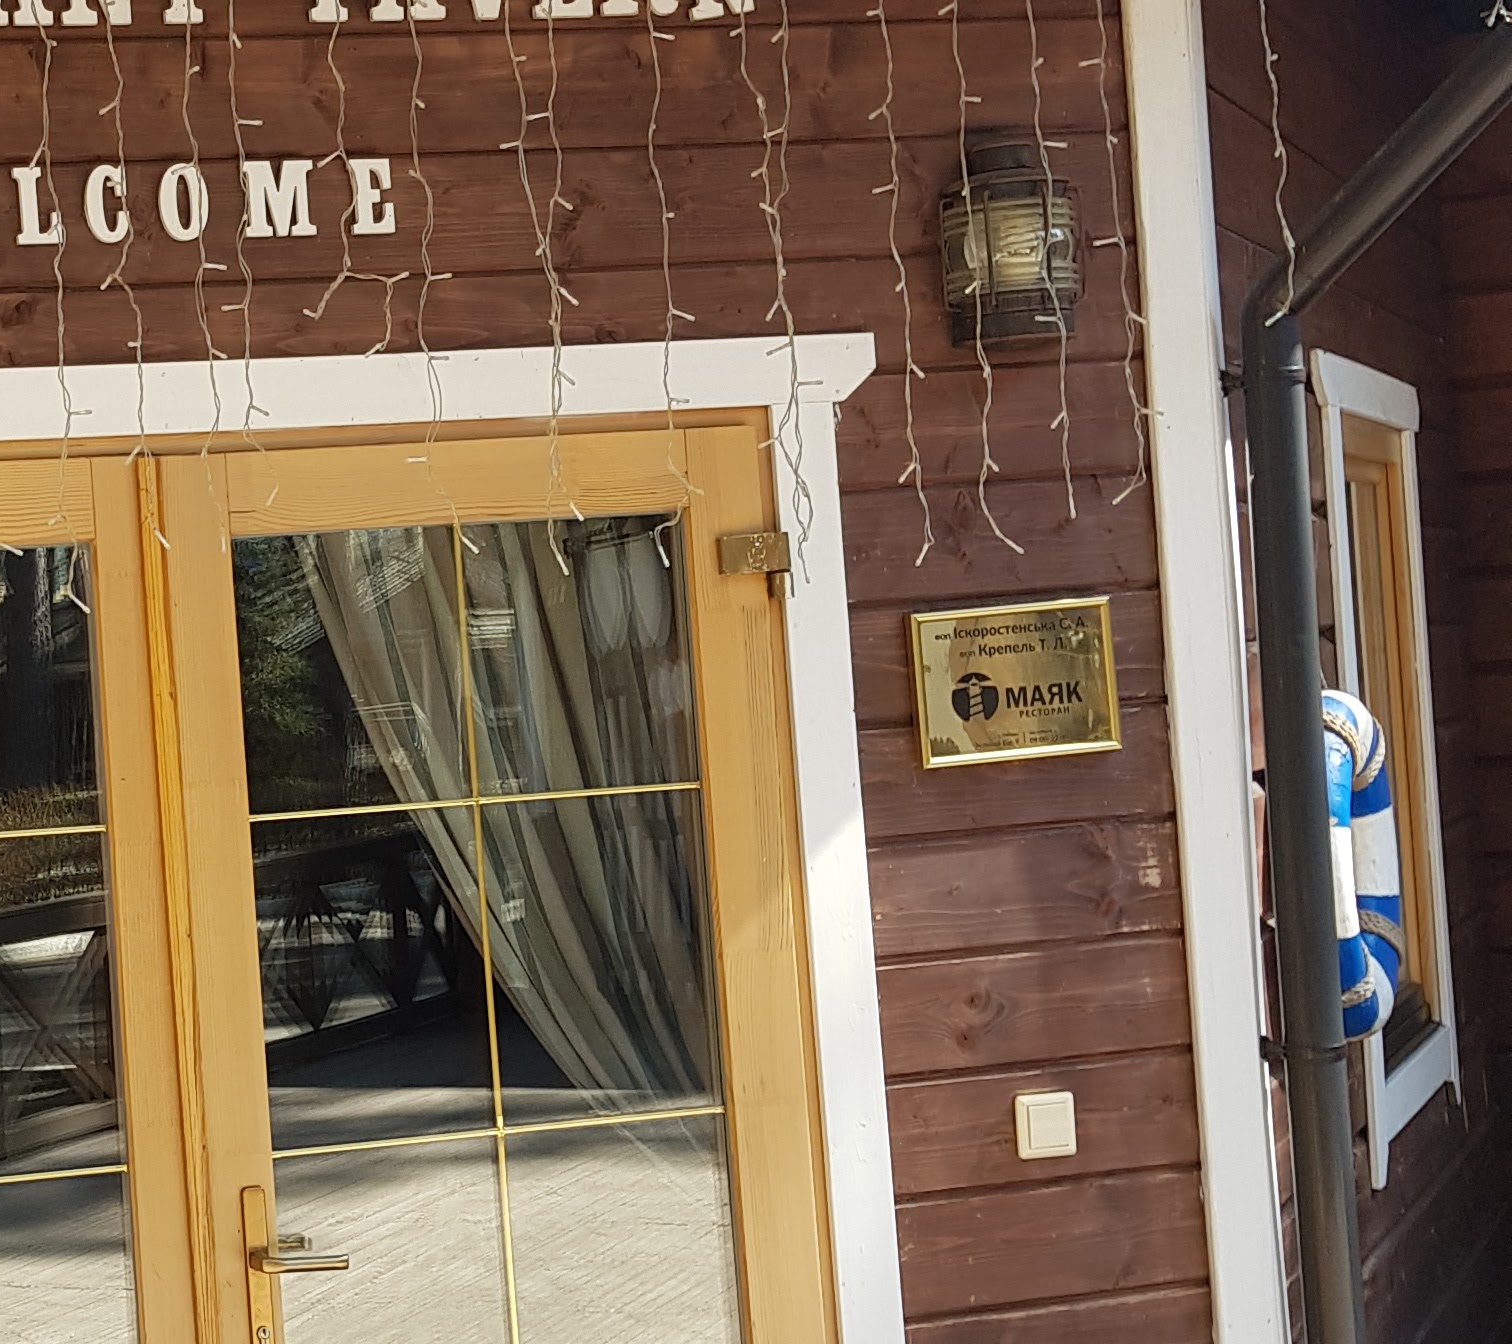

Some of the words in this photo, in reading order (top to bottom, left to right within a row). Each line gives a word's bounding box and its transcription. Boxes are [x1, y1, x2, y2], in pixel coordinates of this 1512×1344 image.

[978, 641, 1036, 658] Крепель
[1005, 680, 1083, 709] МАЯК
[1019, 706, 1070, 719] РЕСТОРАН
